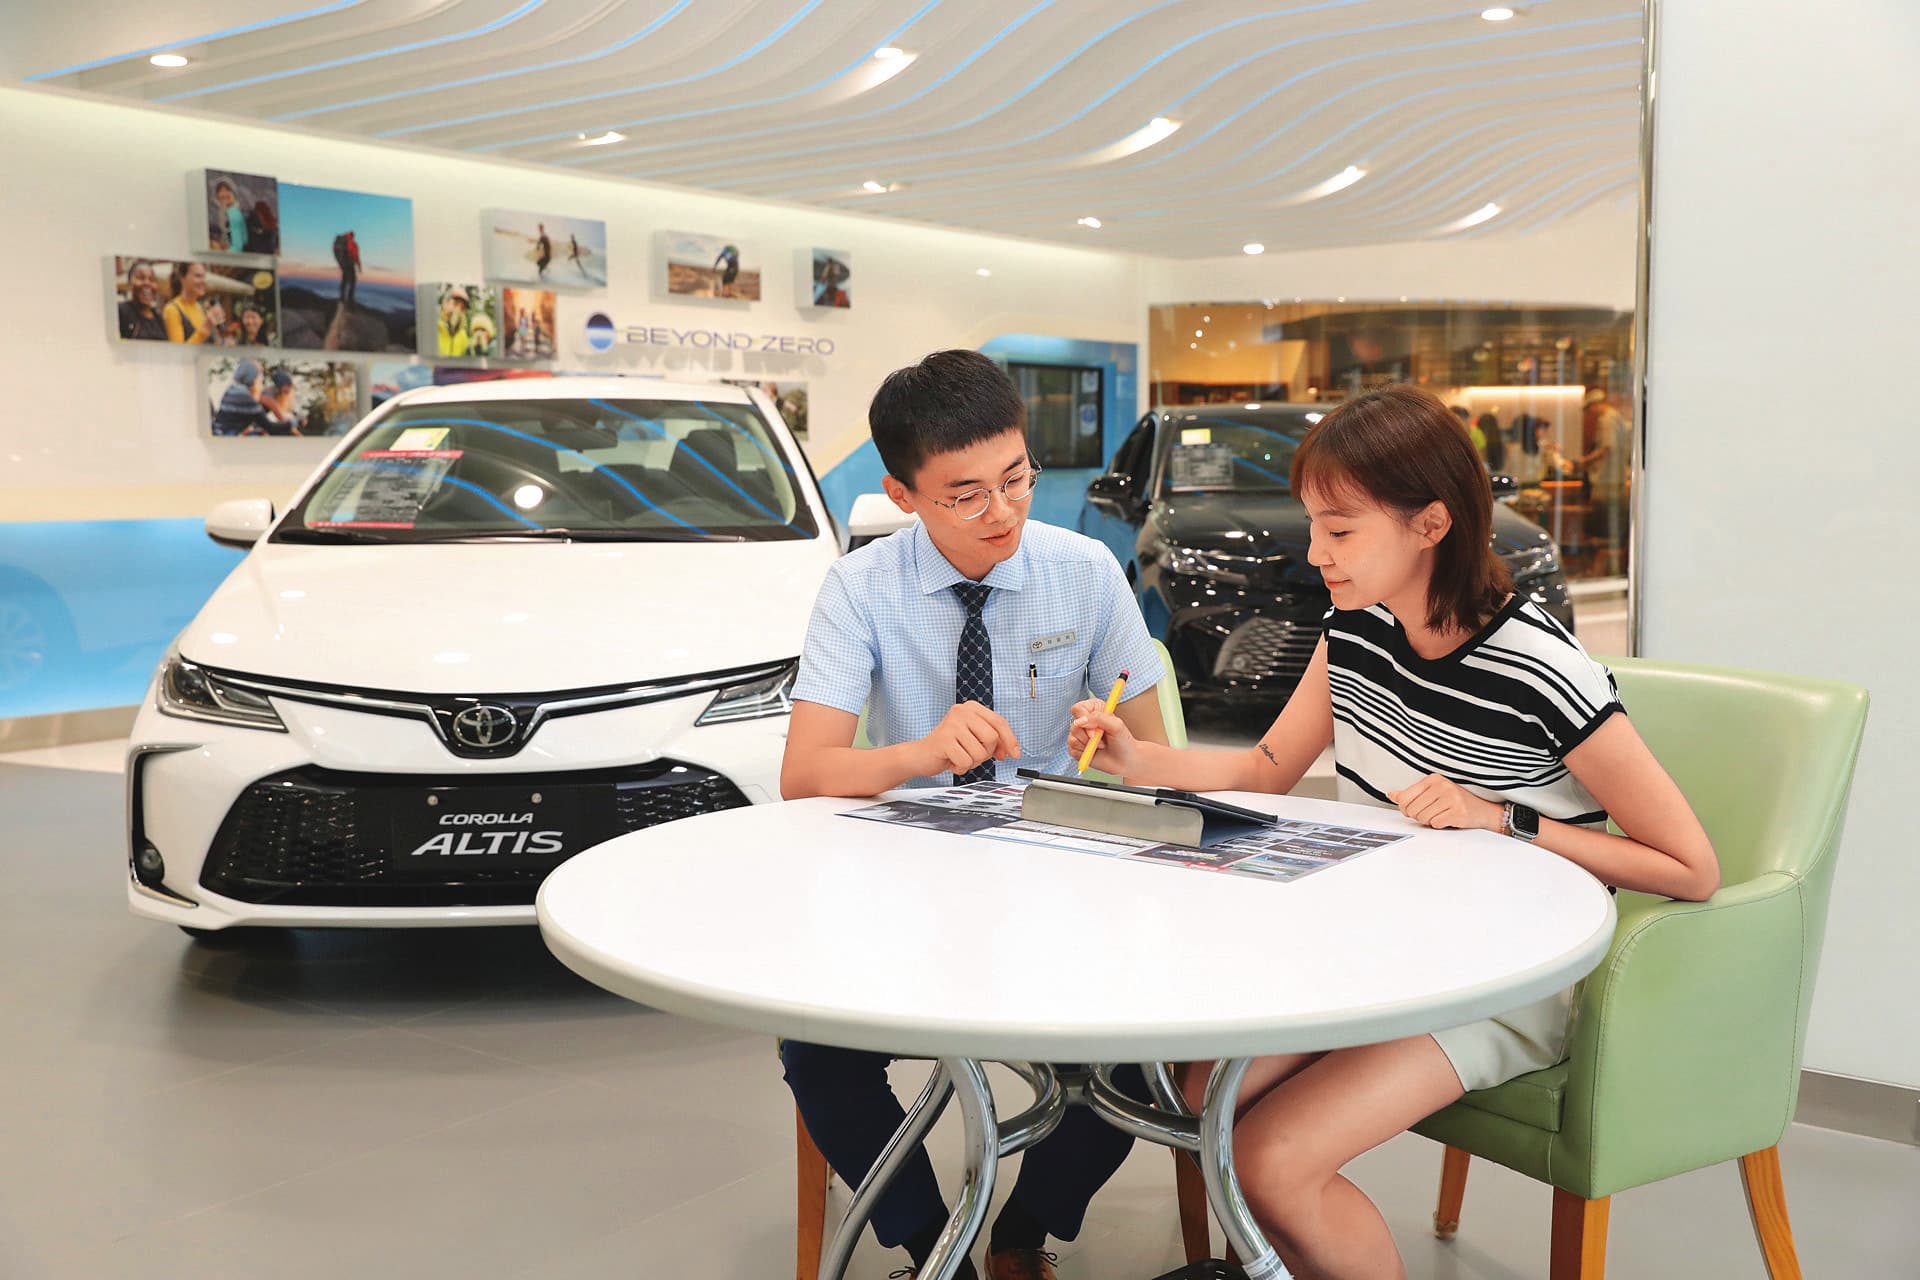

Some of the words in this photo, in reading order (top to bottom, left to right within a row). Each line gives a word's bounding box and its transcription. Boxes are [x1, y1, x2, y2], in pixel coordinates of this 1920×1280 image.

[626, 326, 753, 350] BEYOND
[761, 335, 835, 356] ZERO
[439, 813, 534, 825] COROLLA
[411, 831, 563, 856] ALTIS
